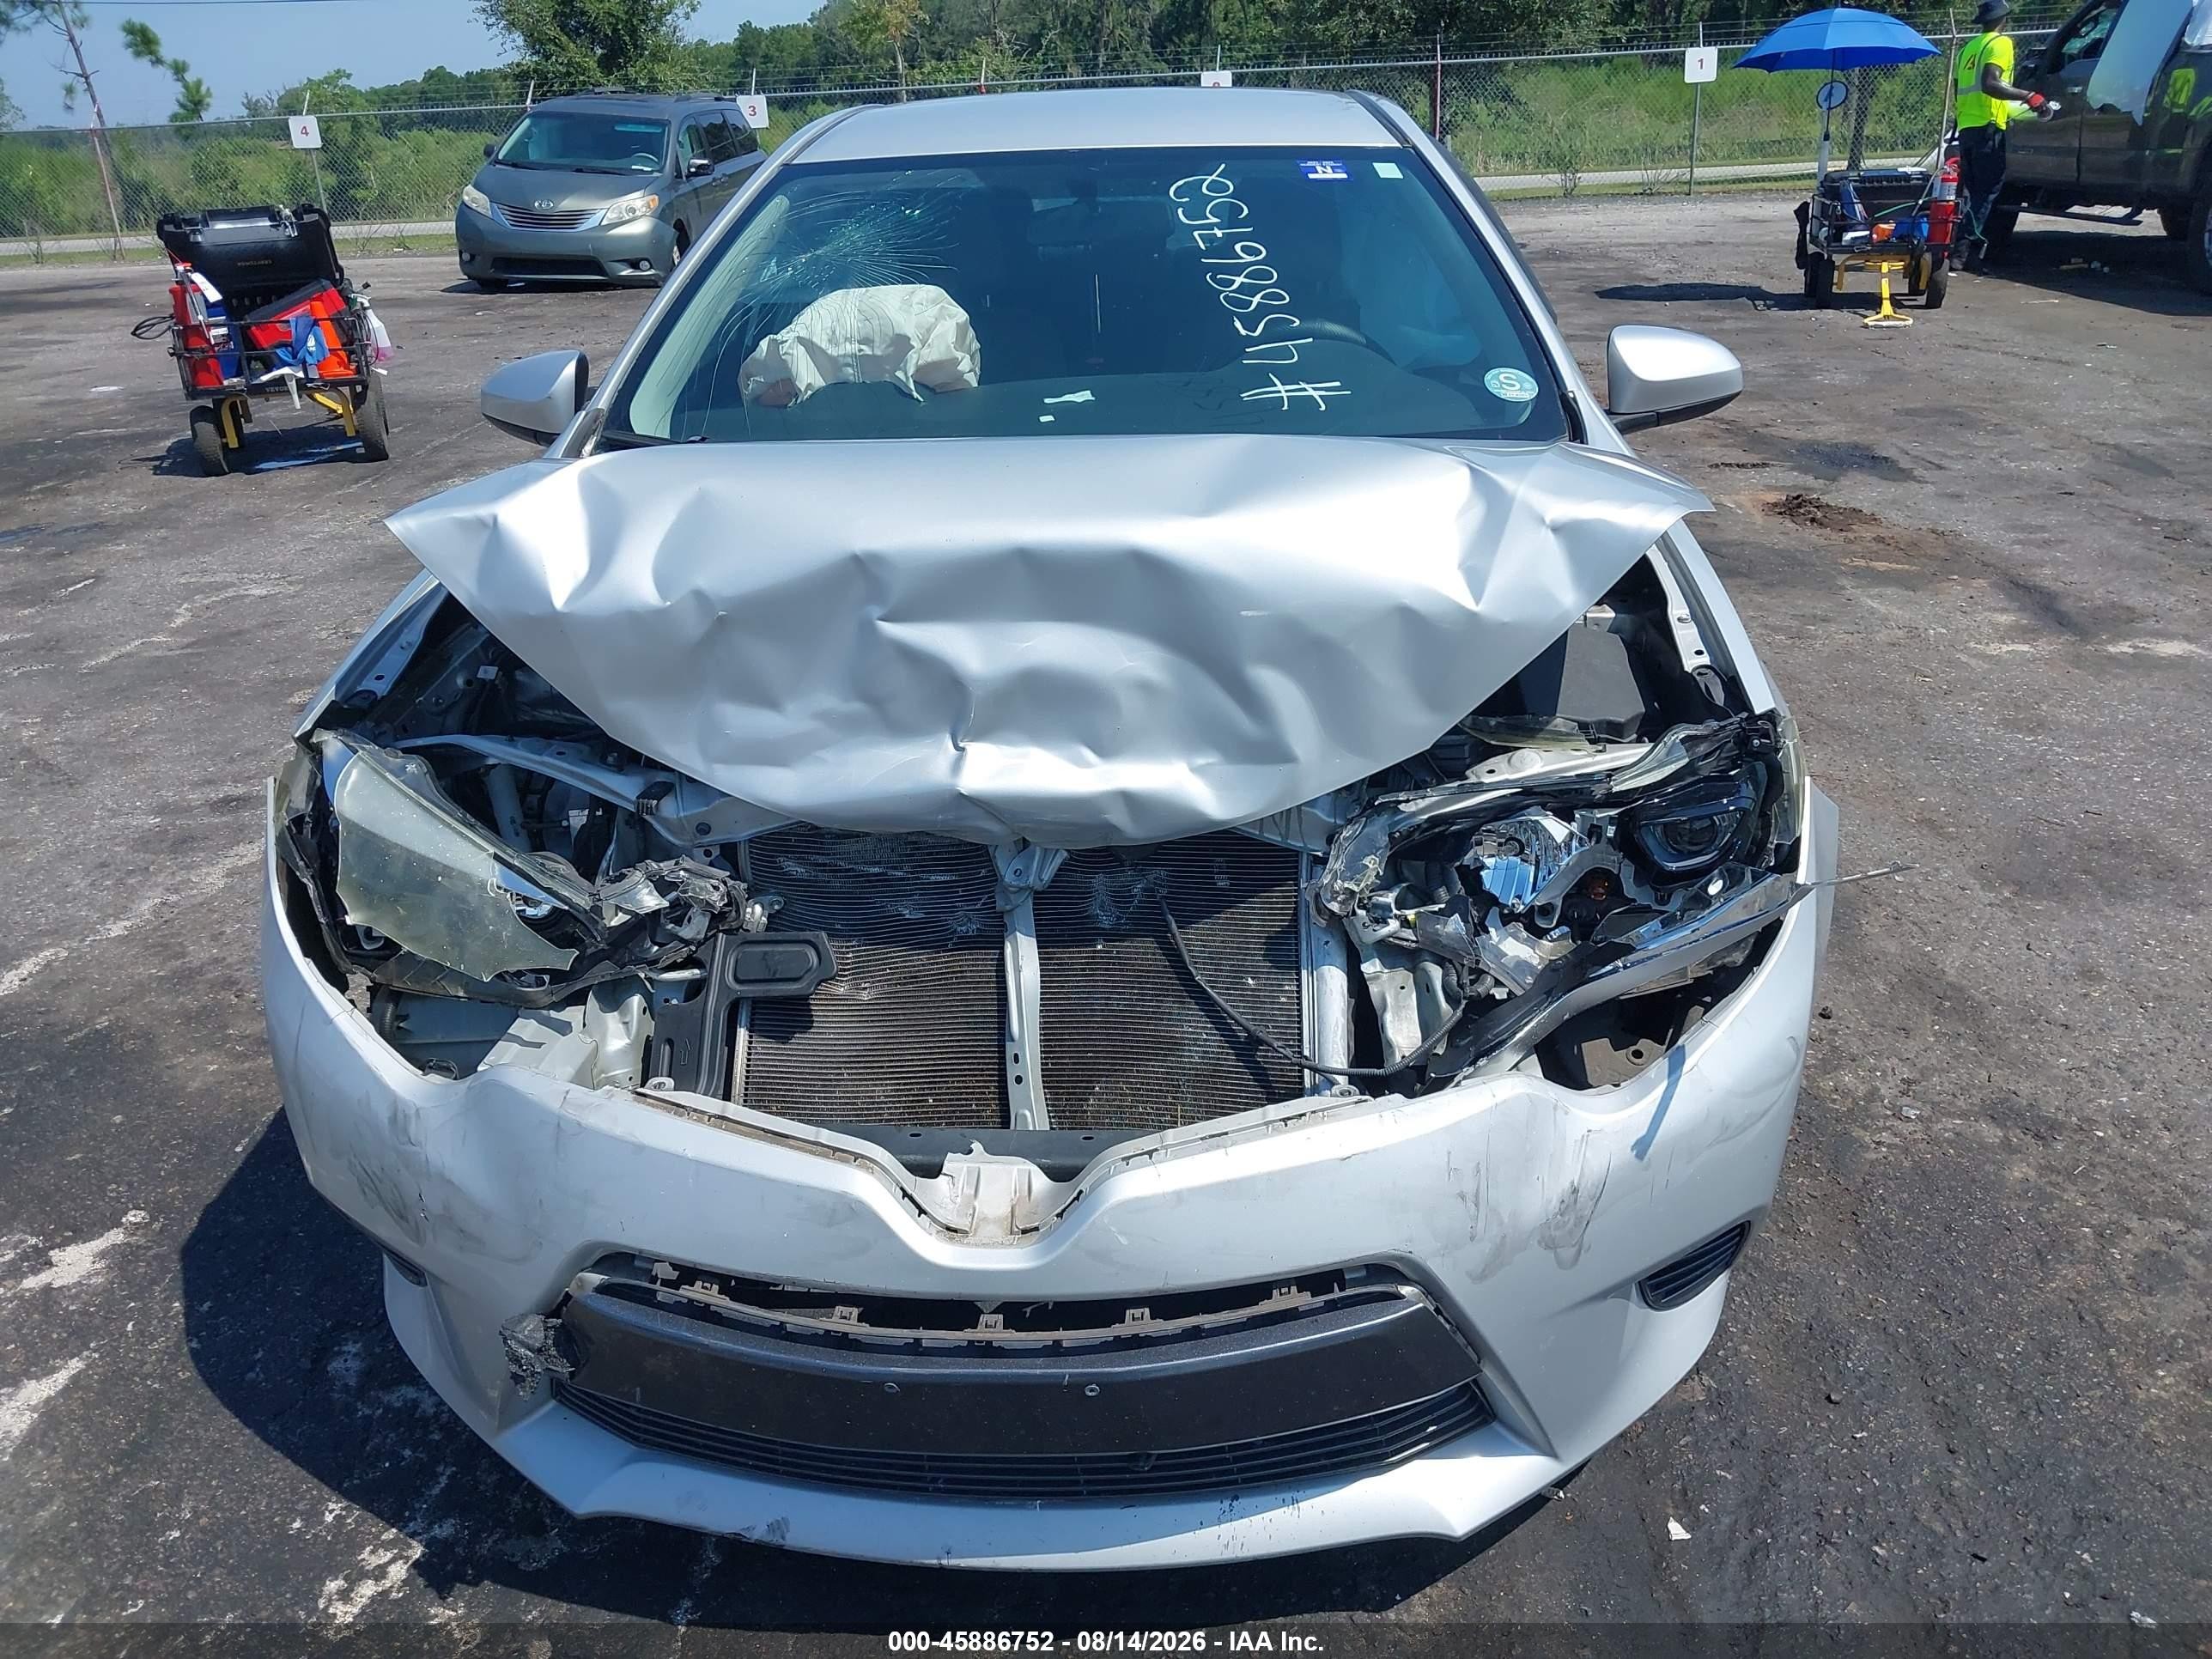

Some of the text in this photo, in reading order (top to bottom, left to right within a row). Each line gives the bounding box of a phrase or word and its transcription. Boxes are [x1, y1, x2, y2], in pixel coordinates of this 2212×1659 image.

[1697, 58, 1705, 70] 1
[748, 105, 757, 117] 3
[301, 125, 309, 137] 4
